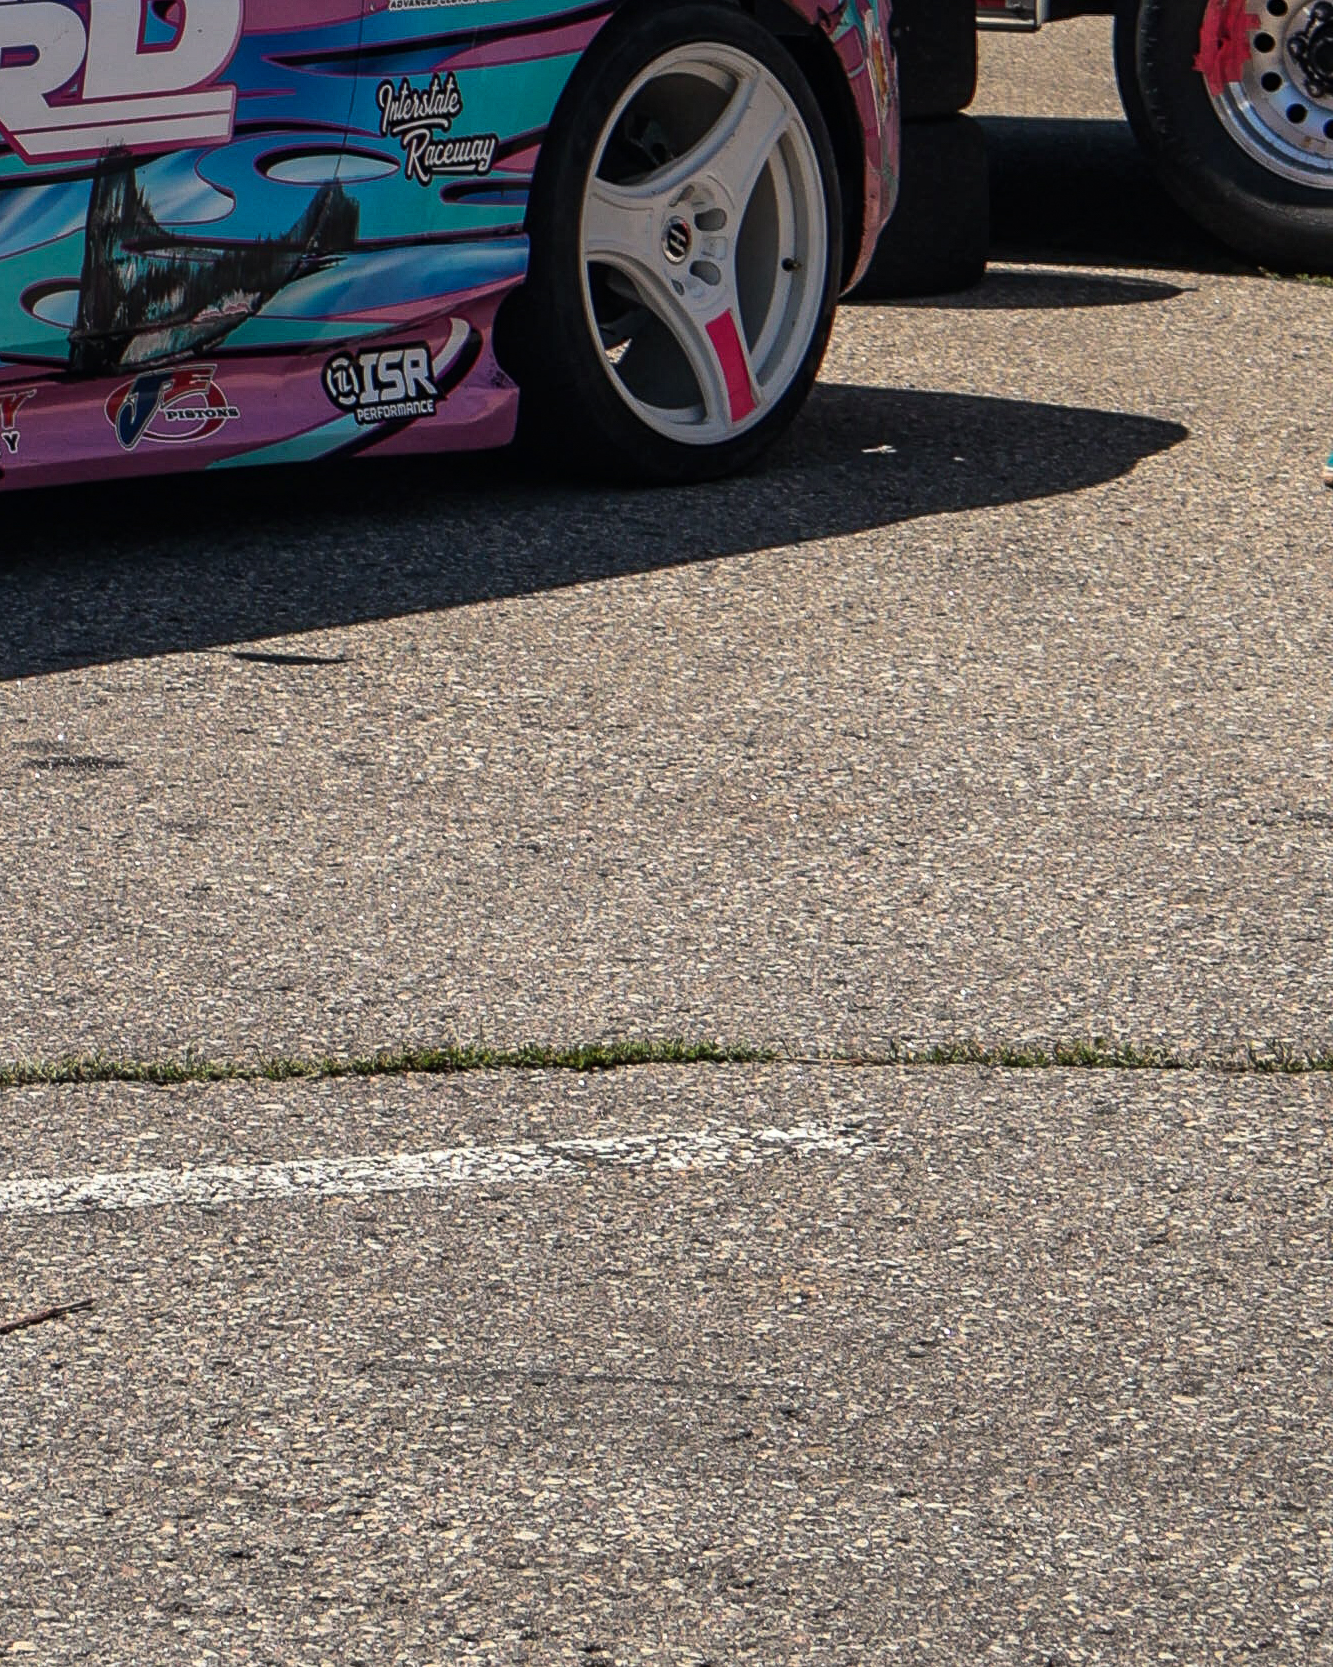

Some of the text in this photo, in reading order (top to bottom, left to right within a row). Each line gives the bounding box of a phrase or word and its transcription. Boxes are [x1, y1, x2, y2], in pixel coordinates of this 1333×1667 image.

[379, 74, 461, 133] Interstate
[402, 129, 496, 183] Raceway
[358, 348, 438, 404] ISR
[165, 407, 239, 422] PISTONS
[357, 399, 435, 422] PERFORMANCE
